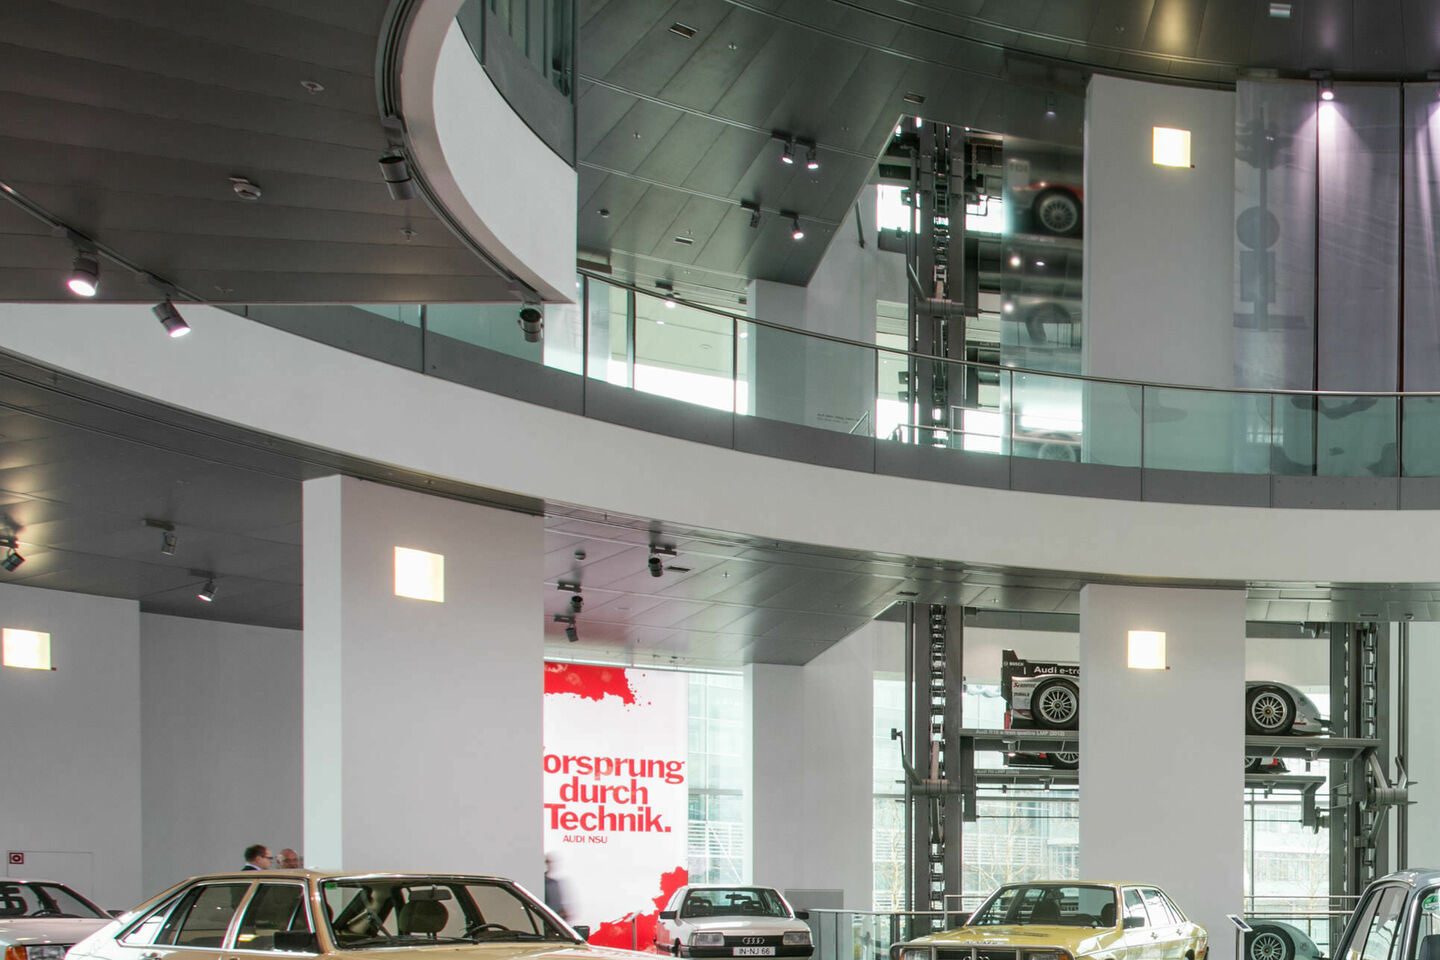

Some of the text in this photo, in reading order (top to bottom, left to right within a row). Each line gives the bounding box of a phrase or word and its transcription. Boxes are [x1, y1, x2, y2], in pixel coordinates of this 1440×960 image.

[1034, 666, 1058, 674] Audi
[543, 754, 685, 784] orsprung
[559, 776, 648, 804] durch
[543, 803, 672, 832] Technik.
[562, 834, 608, 844] AUDI NSU
